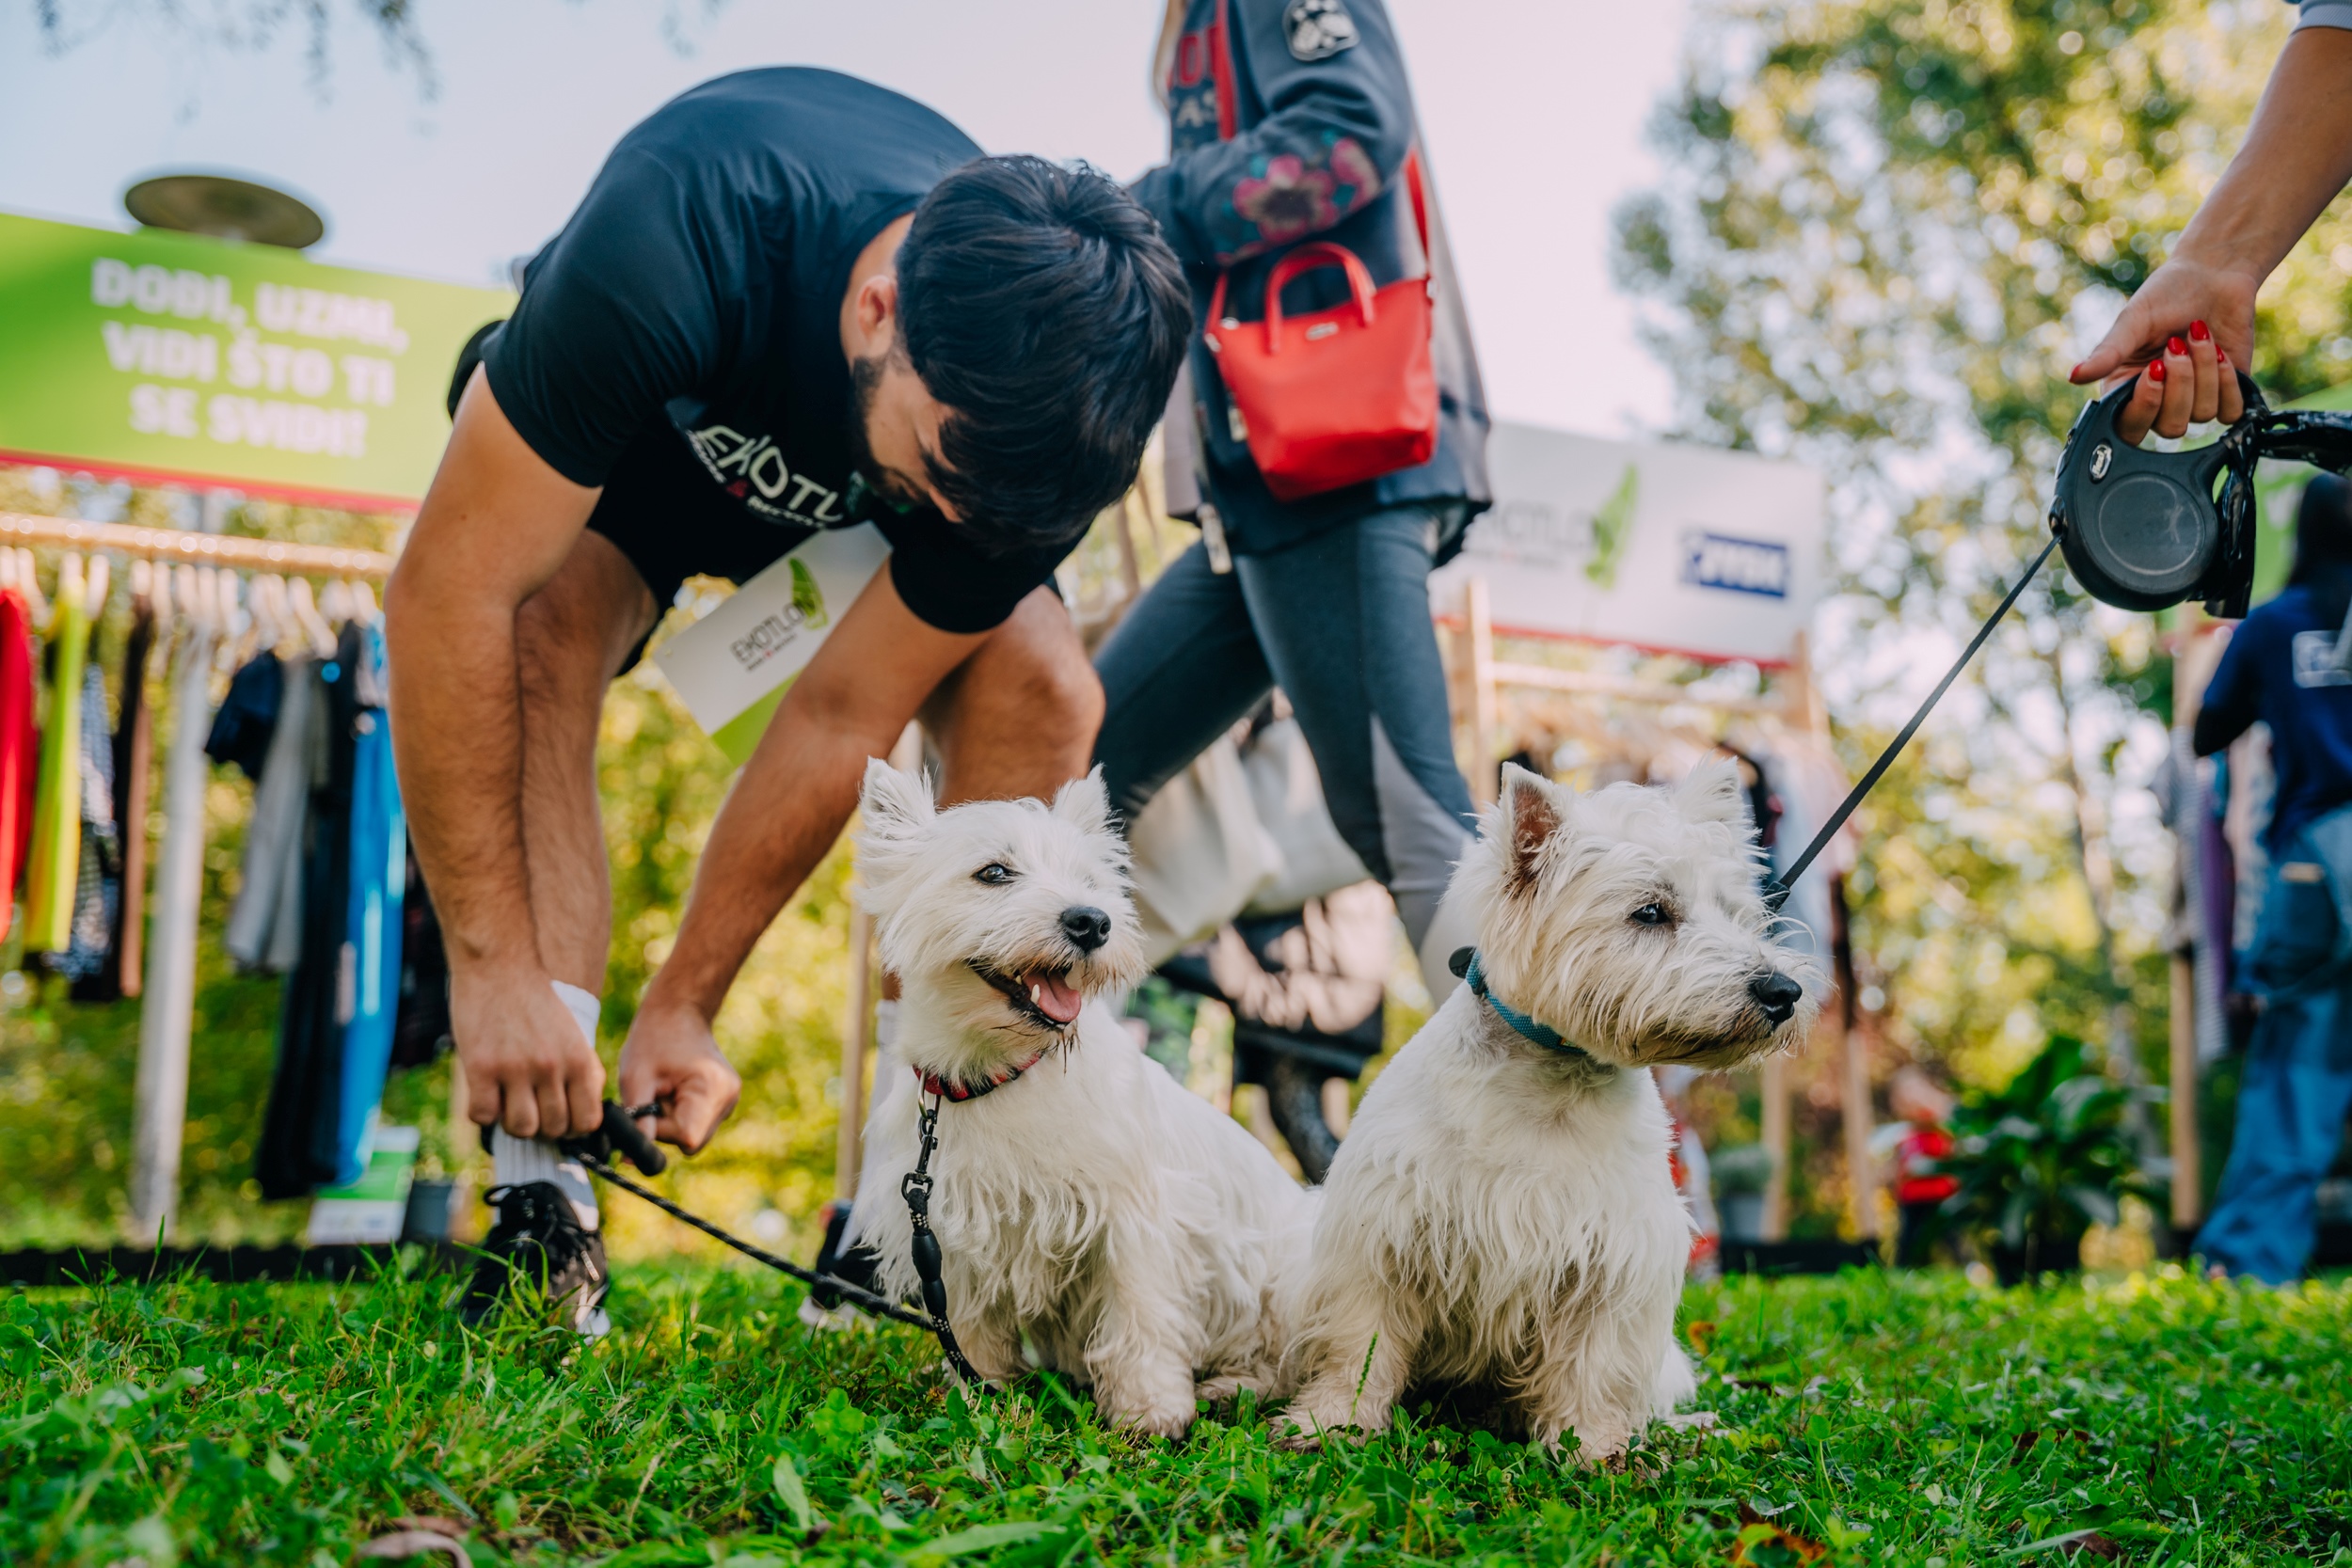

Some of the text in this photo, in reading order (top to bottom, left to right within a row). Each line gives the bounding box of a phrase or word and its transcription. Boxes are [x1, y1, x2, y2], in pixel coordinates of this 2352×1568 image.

[255, 281, 409, 355] UZMI,
[102, 321, 395, 406] VIDI ŠTO TI
[129, 384, 368, 459] SE SVIDI!
